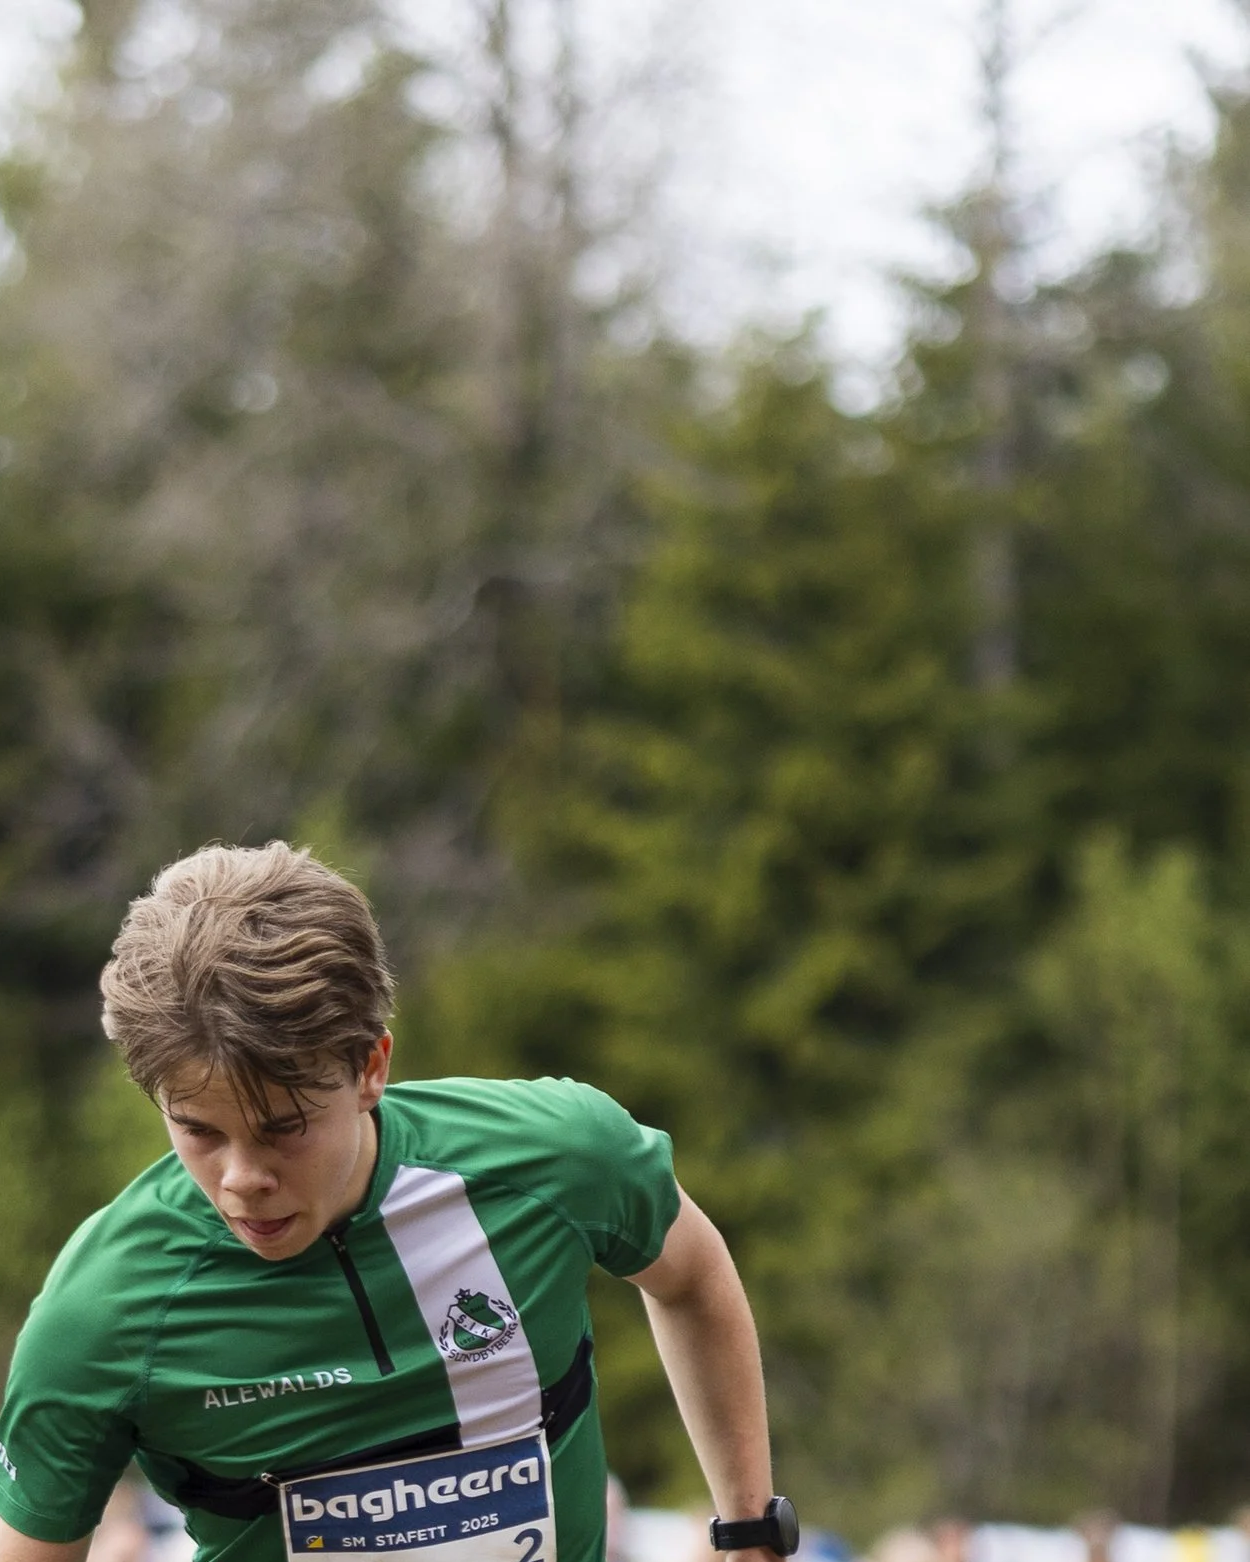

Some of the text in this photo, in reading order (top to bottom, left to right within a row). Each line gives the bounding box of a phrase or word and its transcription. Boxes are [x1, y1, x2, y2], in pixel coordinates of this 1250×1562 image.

[448, 1322, 518, 1362] SUNDBYBERG
[204, 1367, 353, 1409] ALEWALDS
[292, 1456, 540, 1523] bagheera
[342, 1513, 499, 1548] SM STAFETT 2025
